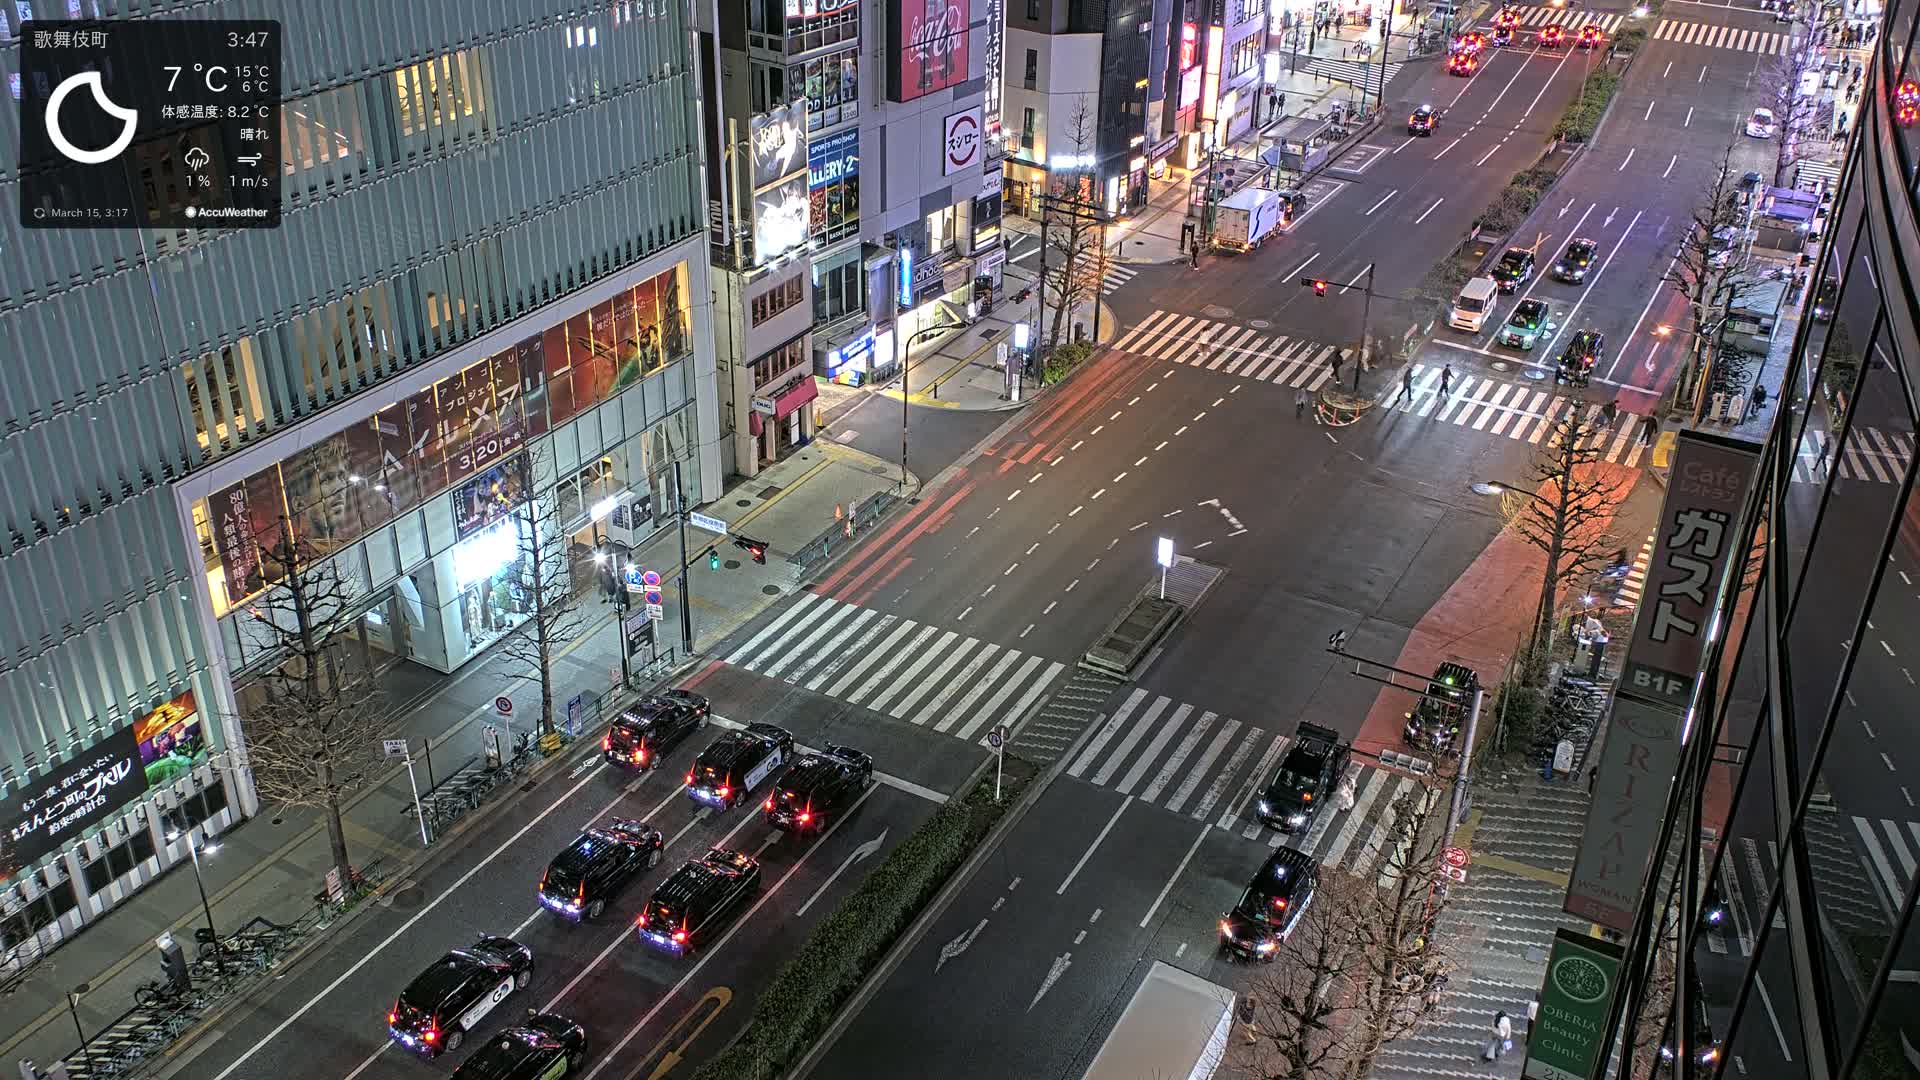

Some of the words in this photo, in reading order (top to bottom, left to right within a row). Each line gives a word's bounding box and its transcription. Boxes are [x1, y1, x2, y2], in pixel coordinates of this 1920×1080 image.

[811, 141, 831, 154] SPORTS
[843, 133, 856, 143] SHOP
[948, 132, 979, 154] スシロー
[710, 199, 722, 233] MUJI
[446, 378, 503, 412] プロジェクト
[459, 439, 498, 471] 3.20
[1650, 509, 1729, 642] ガスト
[1633, 669, 1683, 696] B1F
[20, 758, 131, 837] えんとつ町のプペル
[492, 983, 509, 1003] GO
[1542, 1004, 1598, 1032] OBERIA
[1543, 1020, 1591, 1047] Beauty
[1542, 1038, 1585, 1063] Clinic
